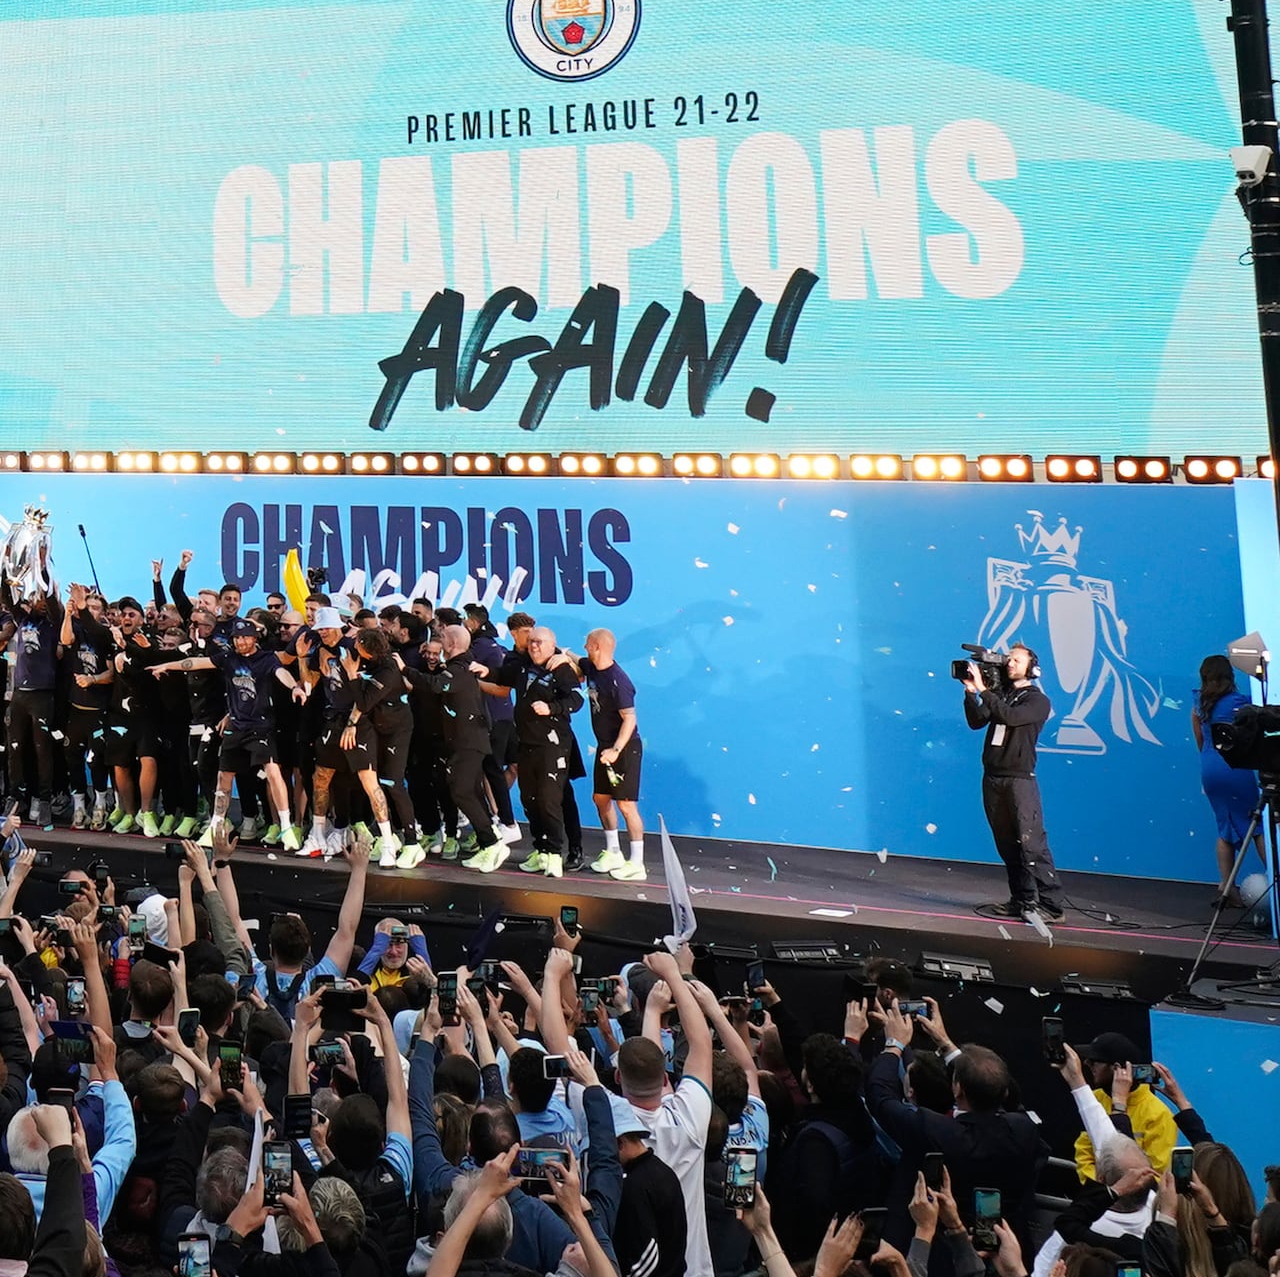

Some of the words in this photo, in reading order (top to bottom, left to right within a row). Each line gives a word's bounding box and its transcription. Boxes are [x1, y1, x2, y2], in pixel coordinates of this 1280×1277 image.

[407, 108, 533, 144] PREMIER
[548, 97, 657, 135] LEAGUE
[673, 90, 761, 127] 21-22
[556, 57, 594, 72] CITY
[211, 118, 1025, 319] CHAMPIONS
[368, 267, 819, 432] AGAIN!
[220, 501, 634, 607] CHAMPIONS
